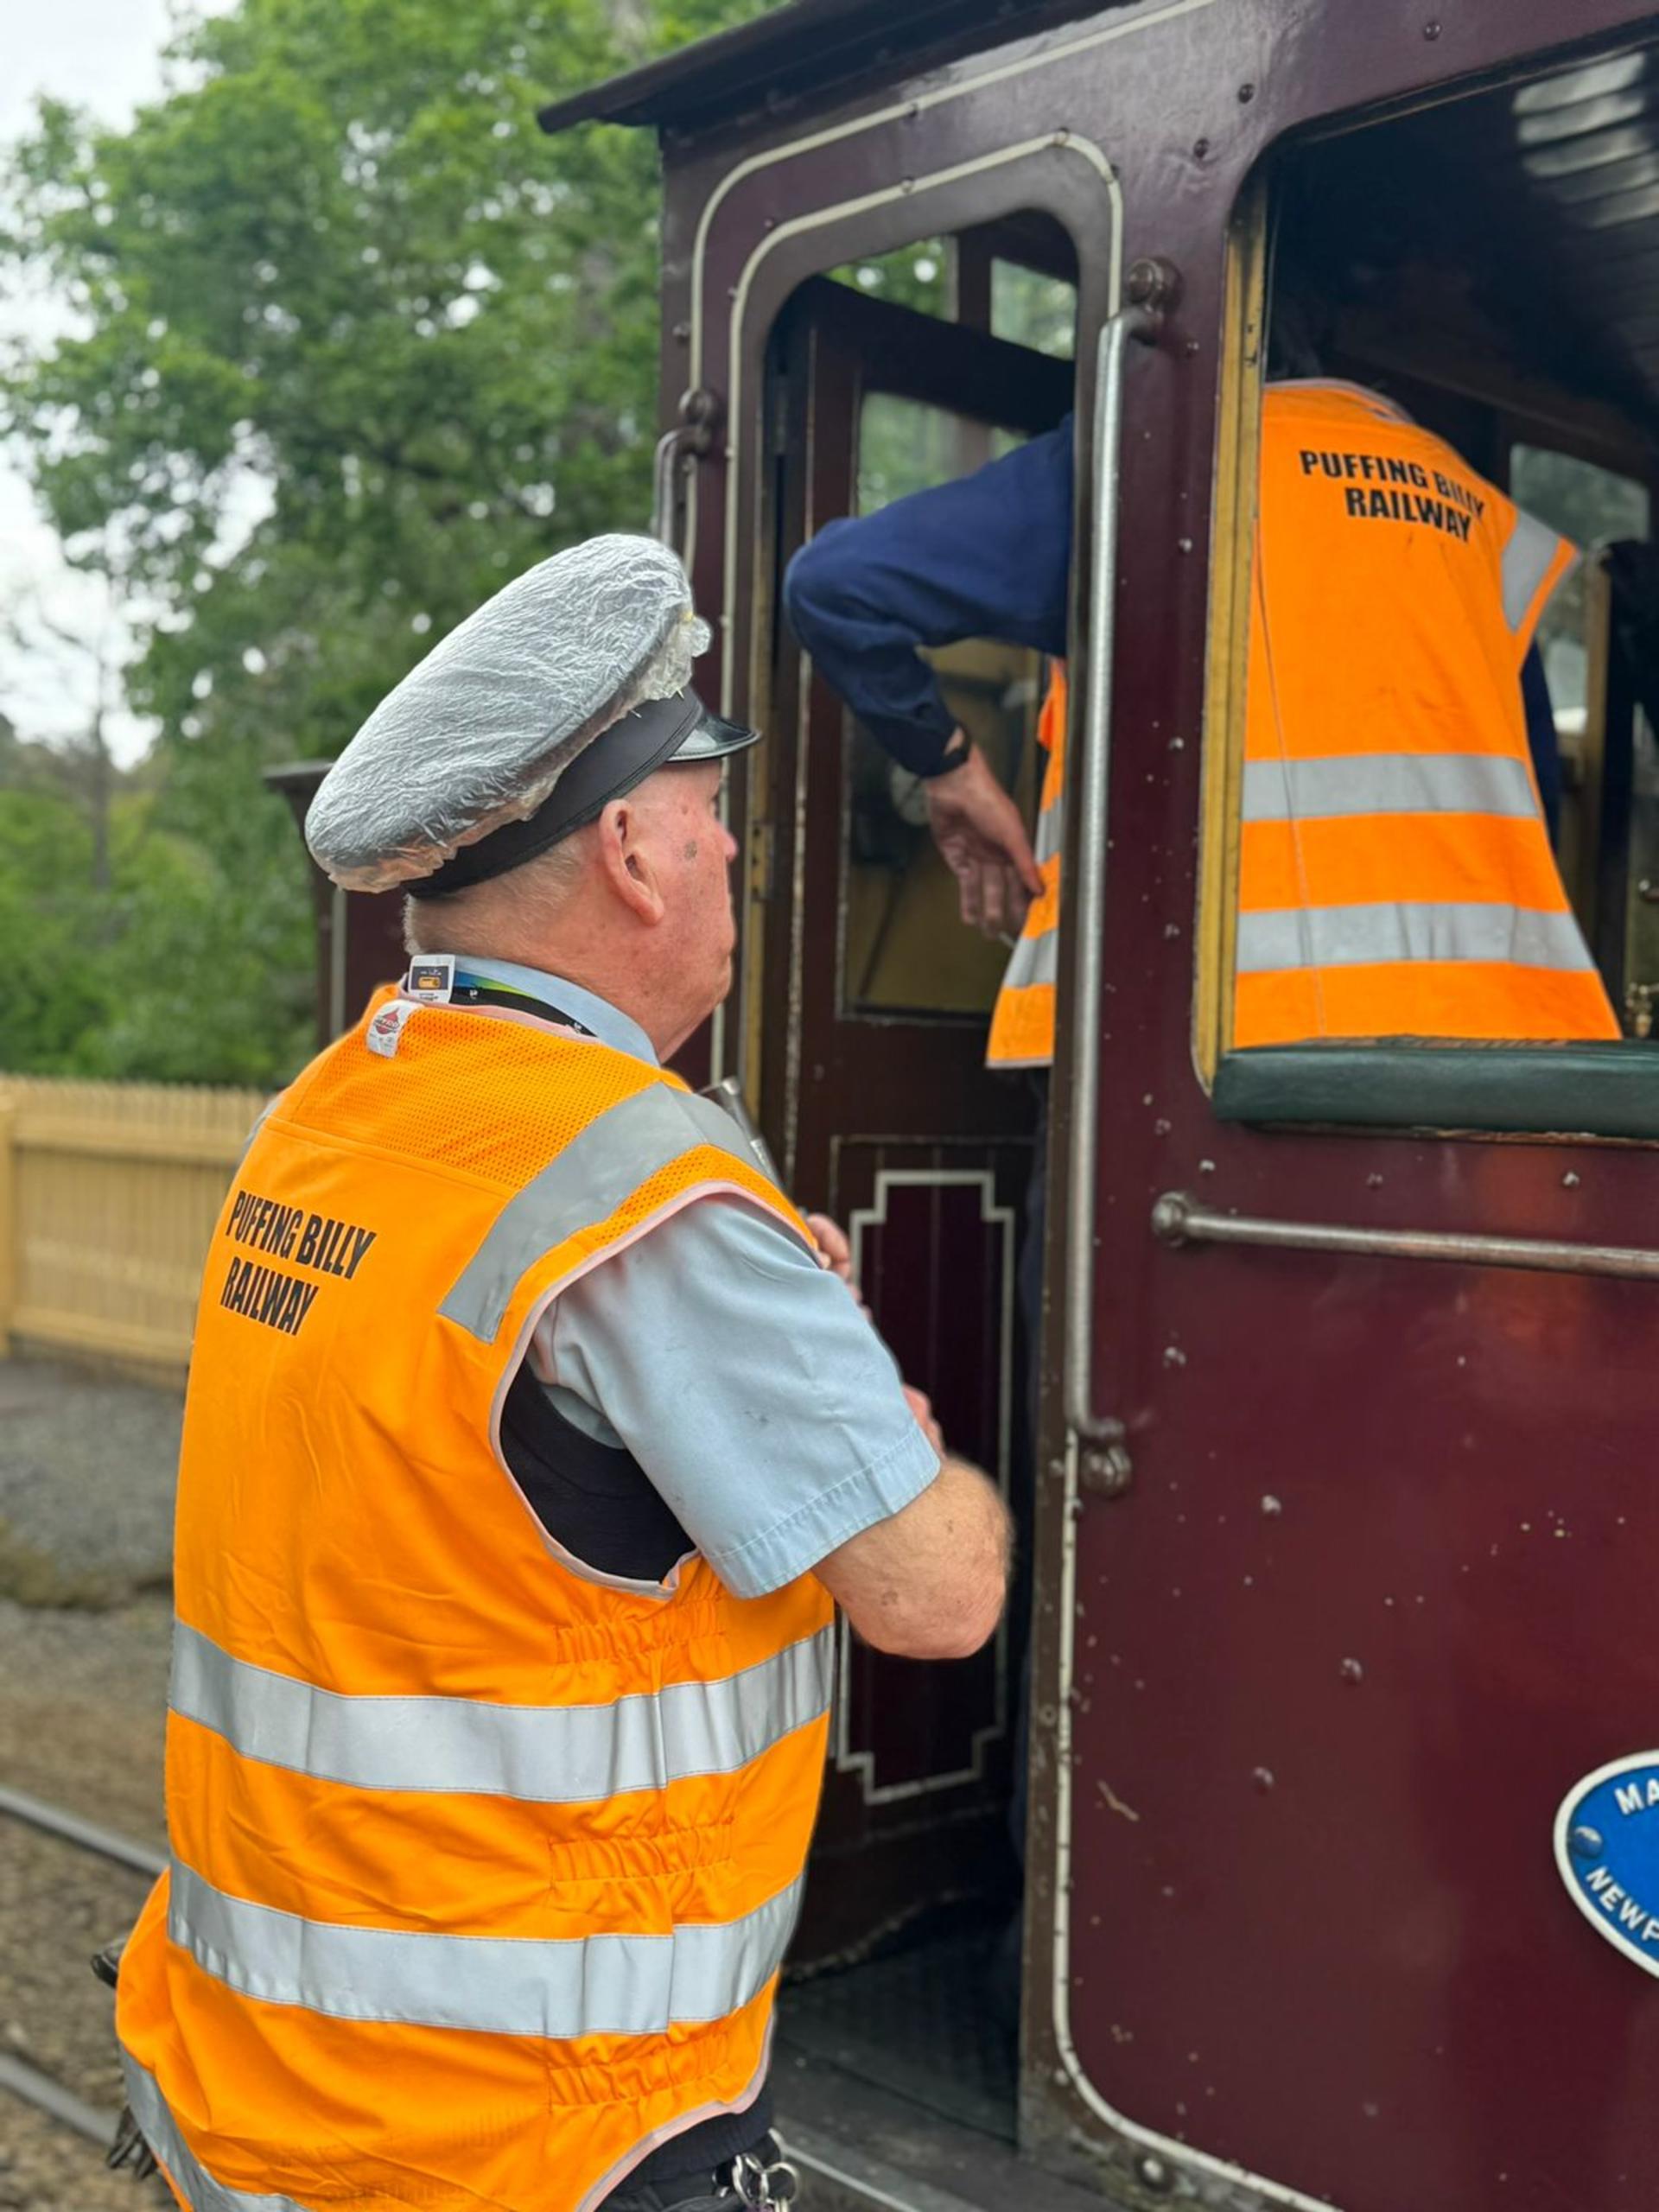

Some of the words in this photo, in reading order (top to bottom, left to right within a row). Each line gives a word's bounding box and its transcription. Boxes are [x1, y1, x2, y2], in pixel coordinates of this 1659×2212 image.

[1300, 449, 1428, 488] PUFFING
[1432, 470, 1484, 517] BILLY
[1344, 487, 1471, 543] RAILWAY
[226, 1190, 304, 1260] PUFFING
[295, 1213, 378, 1280] BILLY
[220, 1255, 320, 1336] RAILWAY
